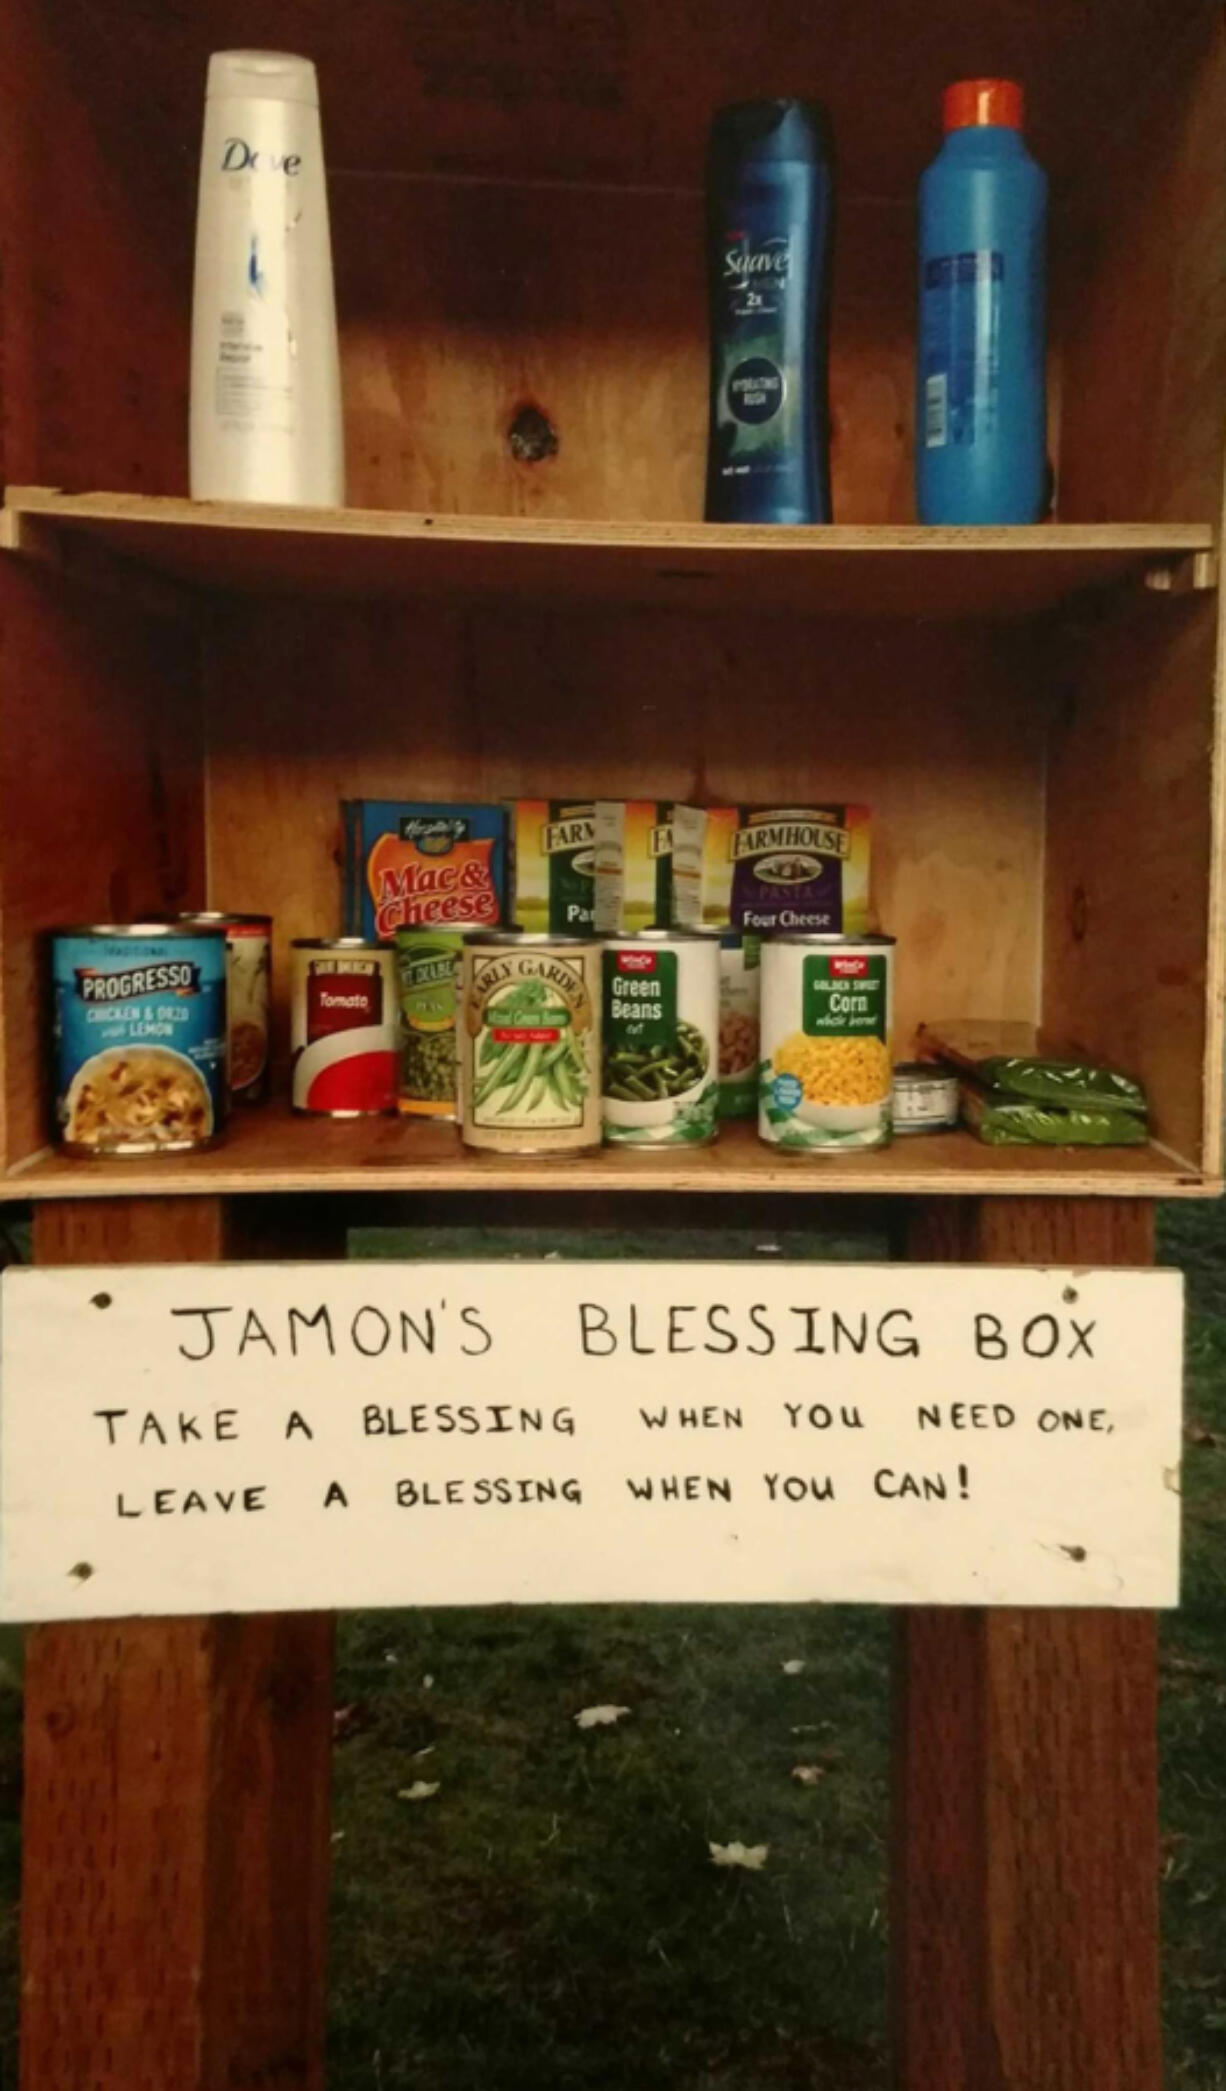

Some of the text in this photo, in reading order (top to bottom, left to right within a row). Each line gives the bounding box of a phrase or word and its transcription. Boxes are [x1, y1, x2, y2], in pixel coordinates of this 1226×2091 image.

[723, 249, 788, 277] Suave
[734, 825, 844, 858] FARMHOUSE
[379, 859, 490, 900] Mac &
[375, 892, 496, 938] Cheese
[743, 910, 831, 928] Four Cheese
[82, 965, 192, 1000] PROGRESSO
[612, 976, 661, 997] Green
[813, 980, 849, 991] GOLDEN
[320, 992, 369, 1009] Tomato
[611, 998, 662, 1019] Beans
[829, 993, 868, 1013] Corn
[86, 1006, 141, 1023] CHICKEN
[129, 1021, 174, 1037] LEMON
[171, 1299, 1097, 1361] JAMON'S BLESSING BOX
[93, 1402, 1115, 1445] TAKE A BLESSING WHEN YOU NEED ONE,
[117, 1463, 971, 1518] LEAVE A BLESSING WHEN YOU CAN!
